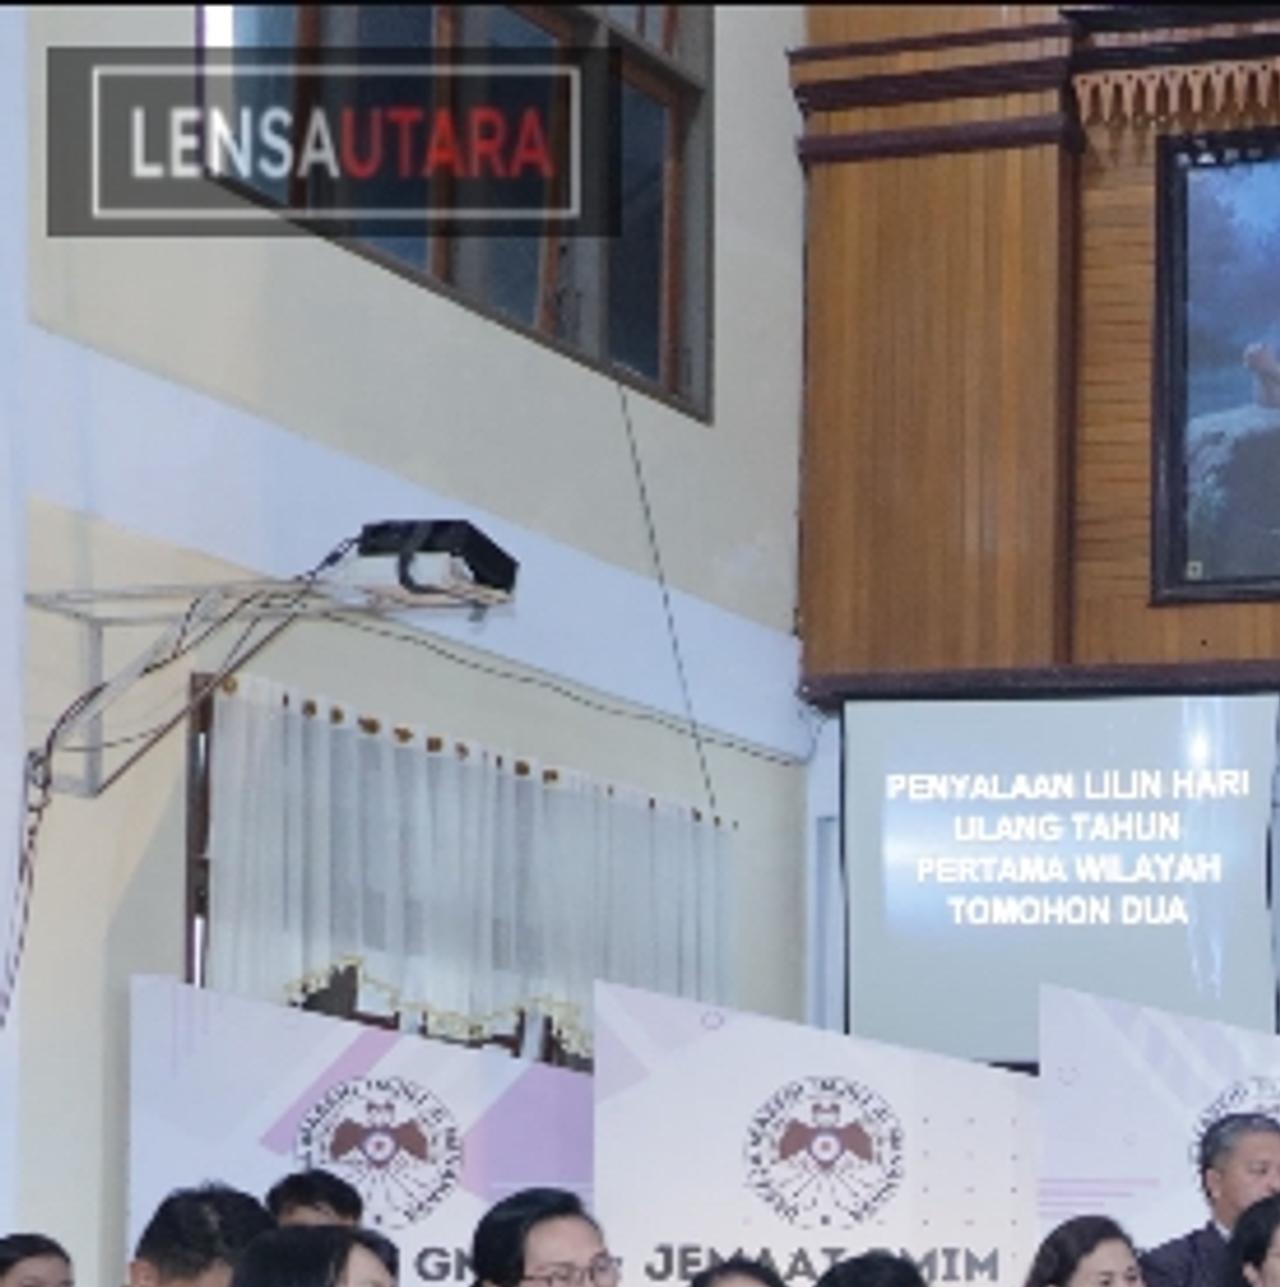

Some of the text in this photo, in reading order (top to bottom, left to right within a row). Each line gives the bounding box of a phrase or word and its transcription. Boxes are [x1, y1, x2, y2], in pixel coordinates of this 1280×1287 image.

[885, 768, 1250, 801] PENYALAAN LILIN HARI
[953, 811, 1181, 842] ULANG TAHUN
[916, 852, 1223, 884] PERTAMA WILAYAH
[946, 895, 1190, 925] TOMOHON DUA
[897, 1246, 999, 1282] MIM
